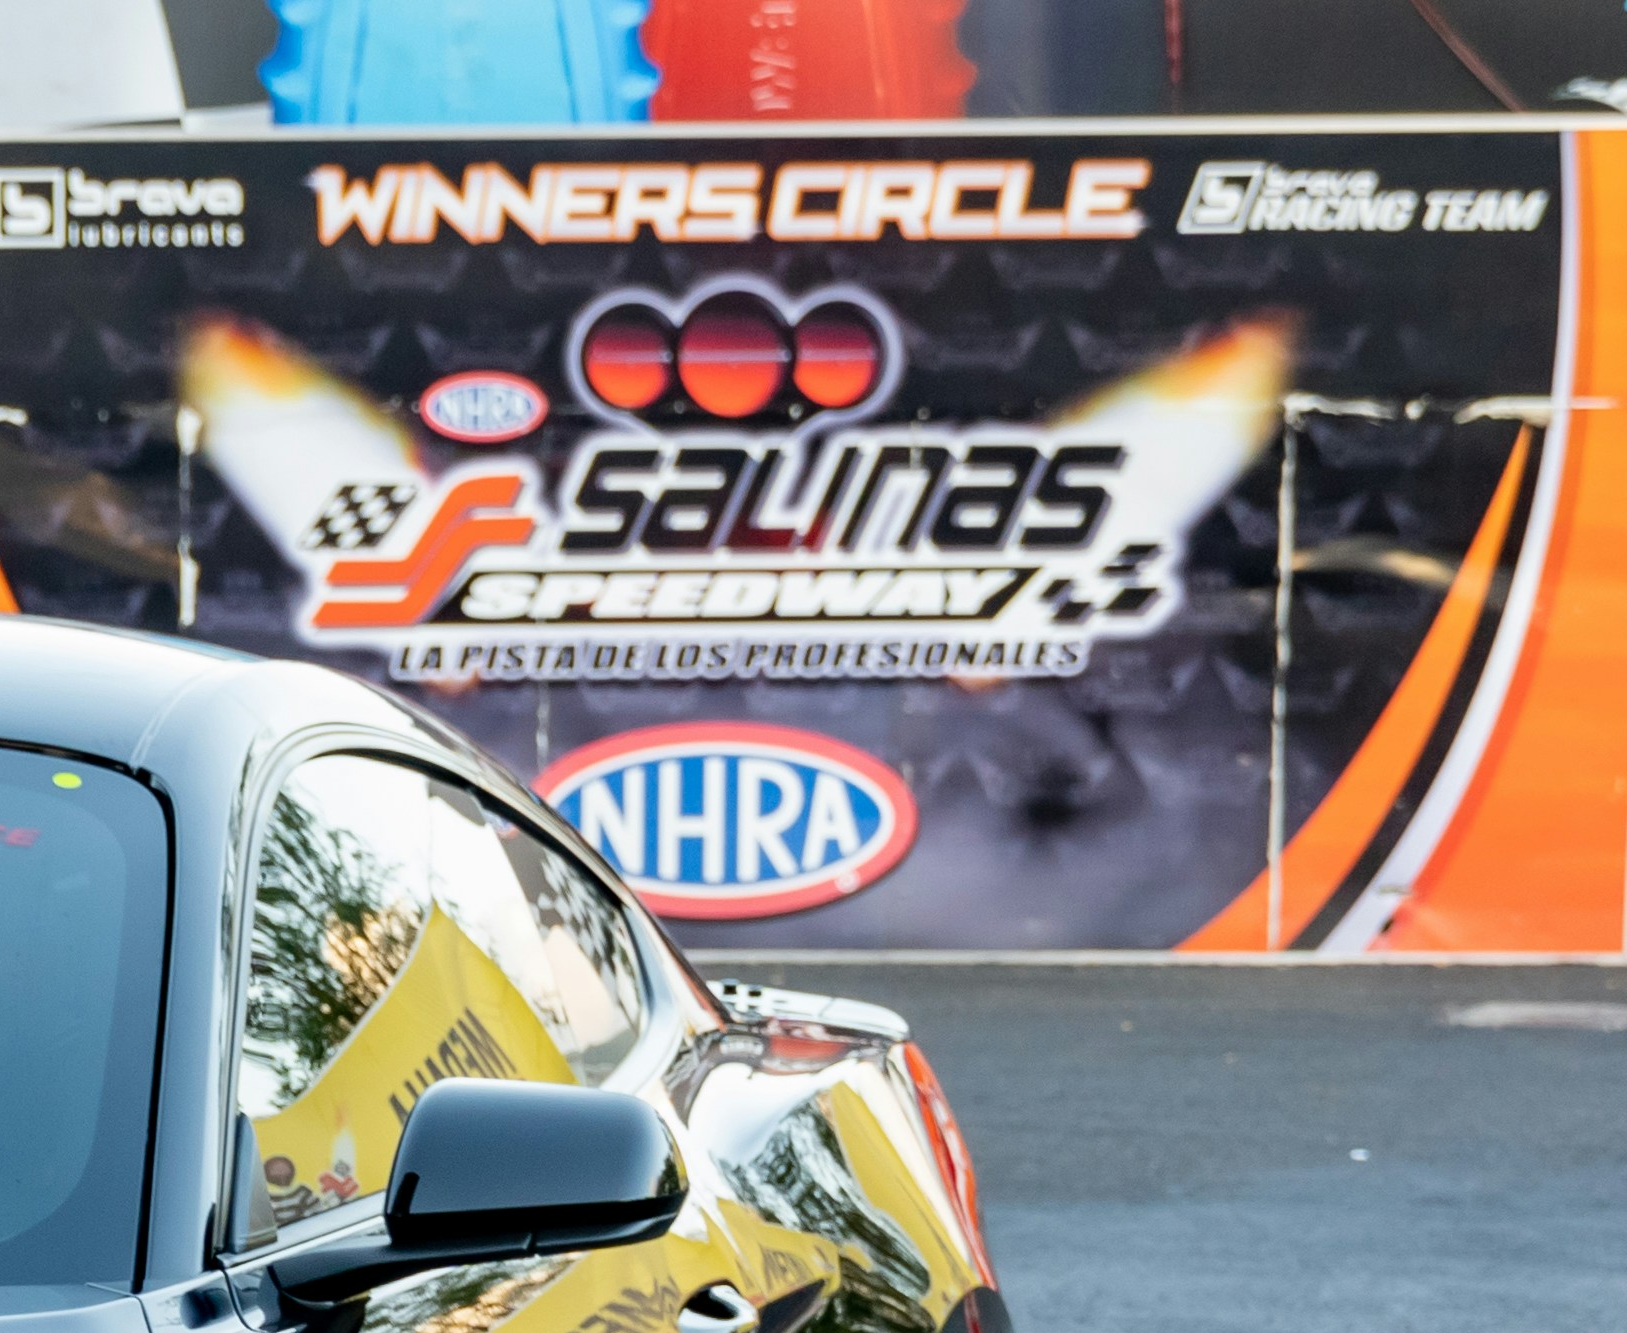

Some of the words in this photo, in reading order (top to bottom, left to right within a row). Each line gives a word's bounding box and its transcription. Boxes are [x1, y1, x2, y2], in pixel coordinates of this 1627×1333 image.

[68, 167, 244, 216] brava
[312, 161, 763, 246] WINNERS
[766, 157, 1152, 242] CIRCLE
[1247, 190, 1419, 232] RACING
[1422, 190, 1550, 232] TEAM
[68, 221, 244, 248] lubricants
[437, 384, 531, 429] NHRA
[460, 571, 1017, 620] SPEEDWAY
[398, 644, 444, 671] LA
[458, 643, 577, 671] PISTA
[585, 643, 641, 670] DE
[655, 643, 732, 670] LOS
[745, 641, 1081, 668] PROFESIONALES
[579, 756, 862, 884] NHRA
